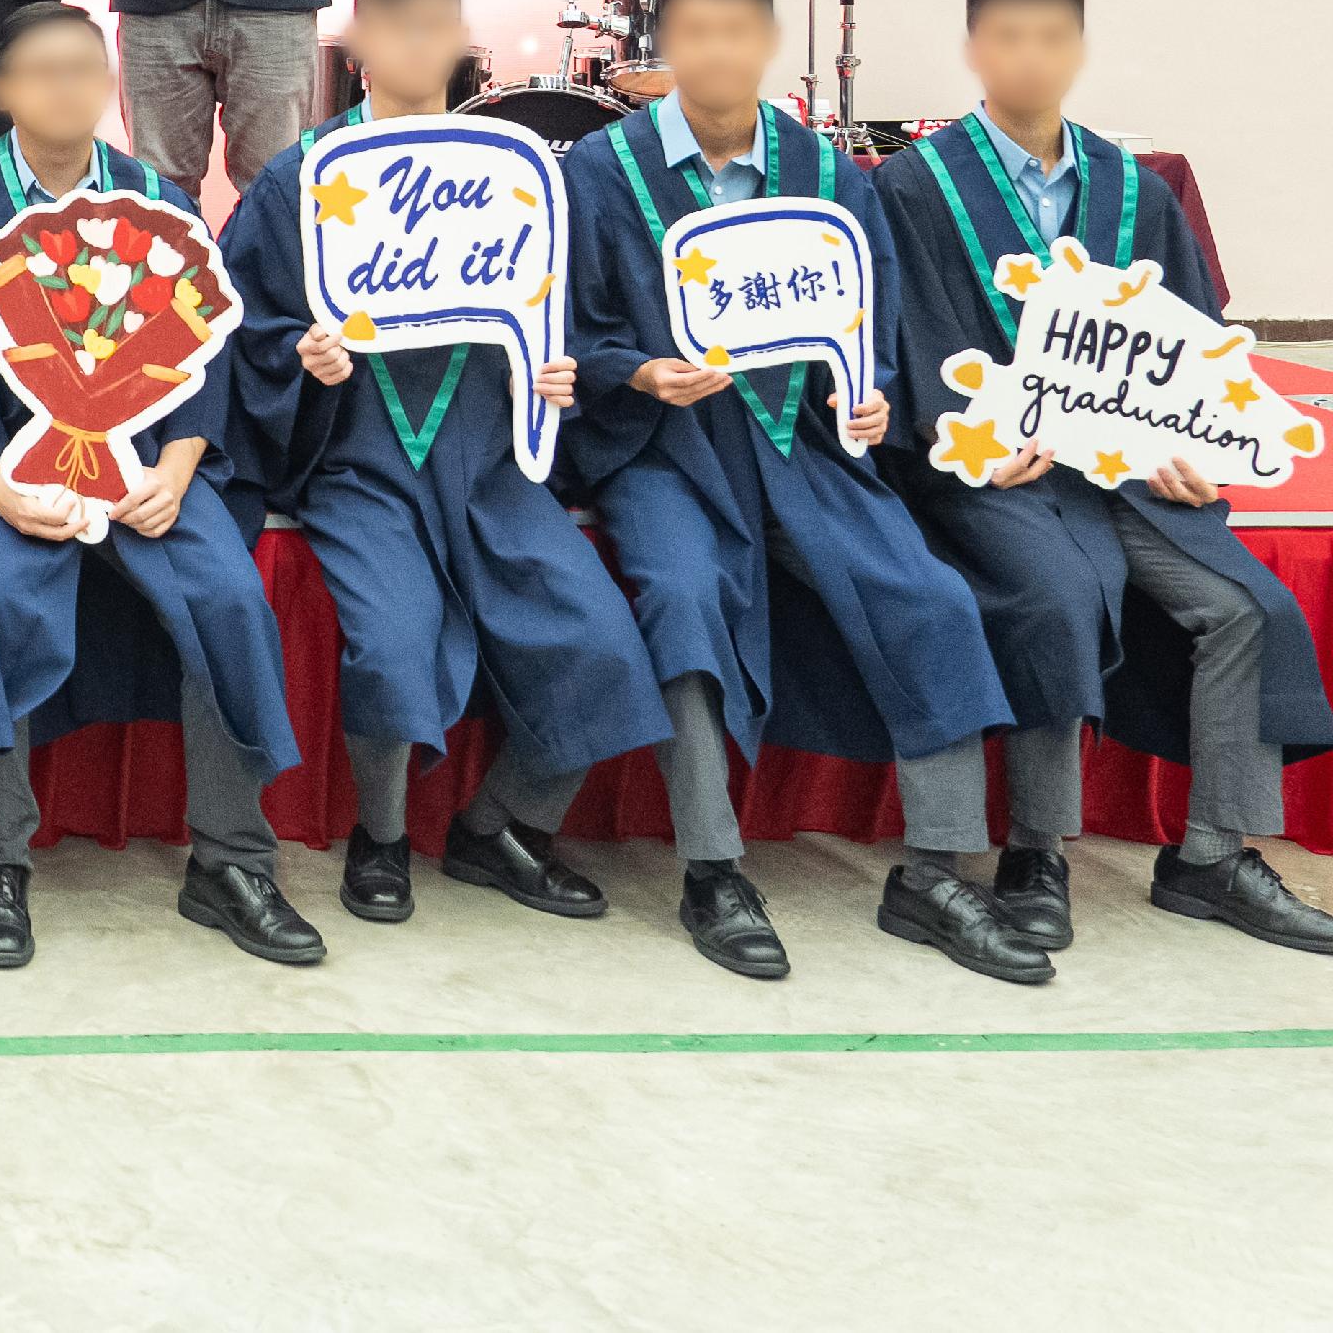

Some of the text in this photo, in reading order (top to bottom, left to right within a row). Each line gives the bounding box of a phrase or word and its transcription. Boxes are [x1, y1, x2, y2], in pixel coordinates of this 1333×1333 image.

[379, 156, 493, 234] You
[347, 224, 533, 294] did it!
[708, 260, 845, 320] 多謝你!
[1042, 308, 1186, 386] HAPPY
[1019, 372, 1281, 477] graduation
